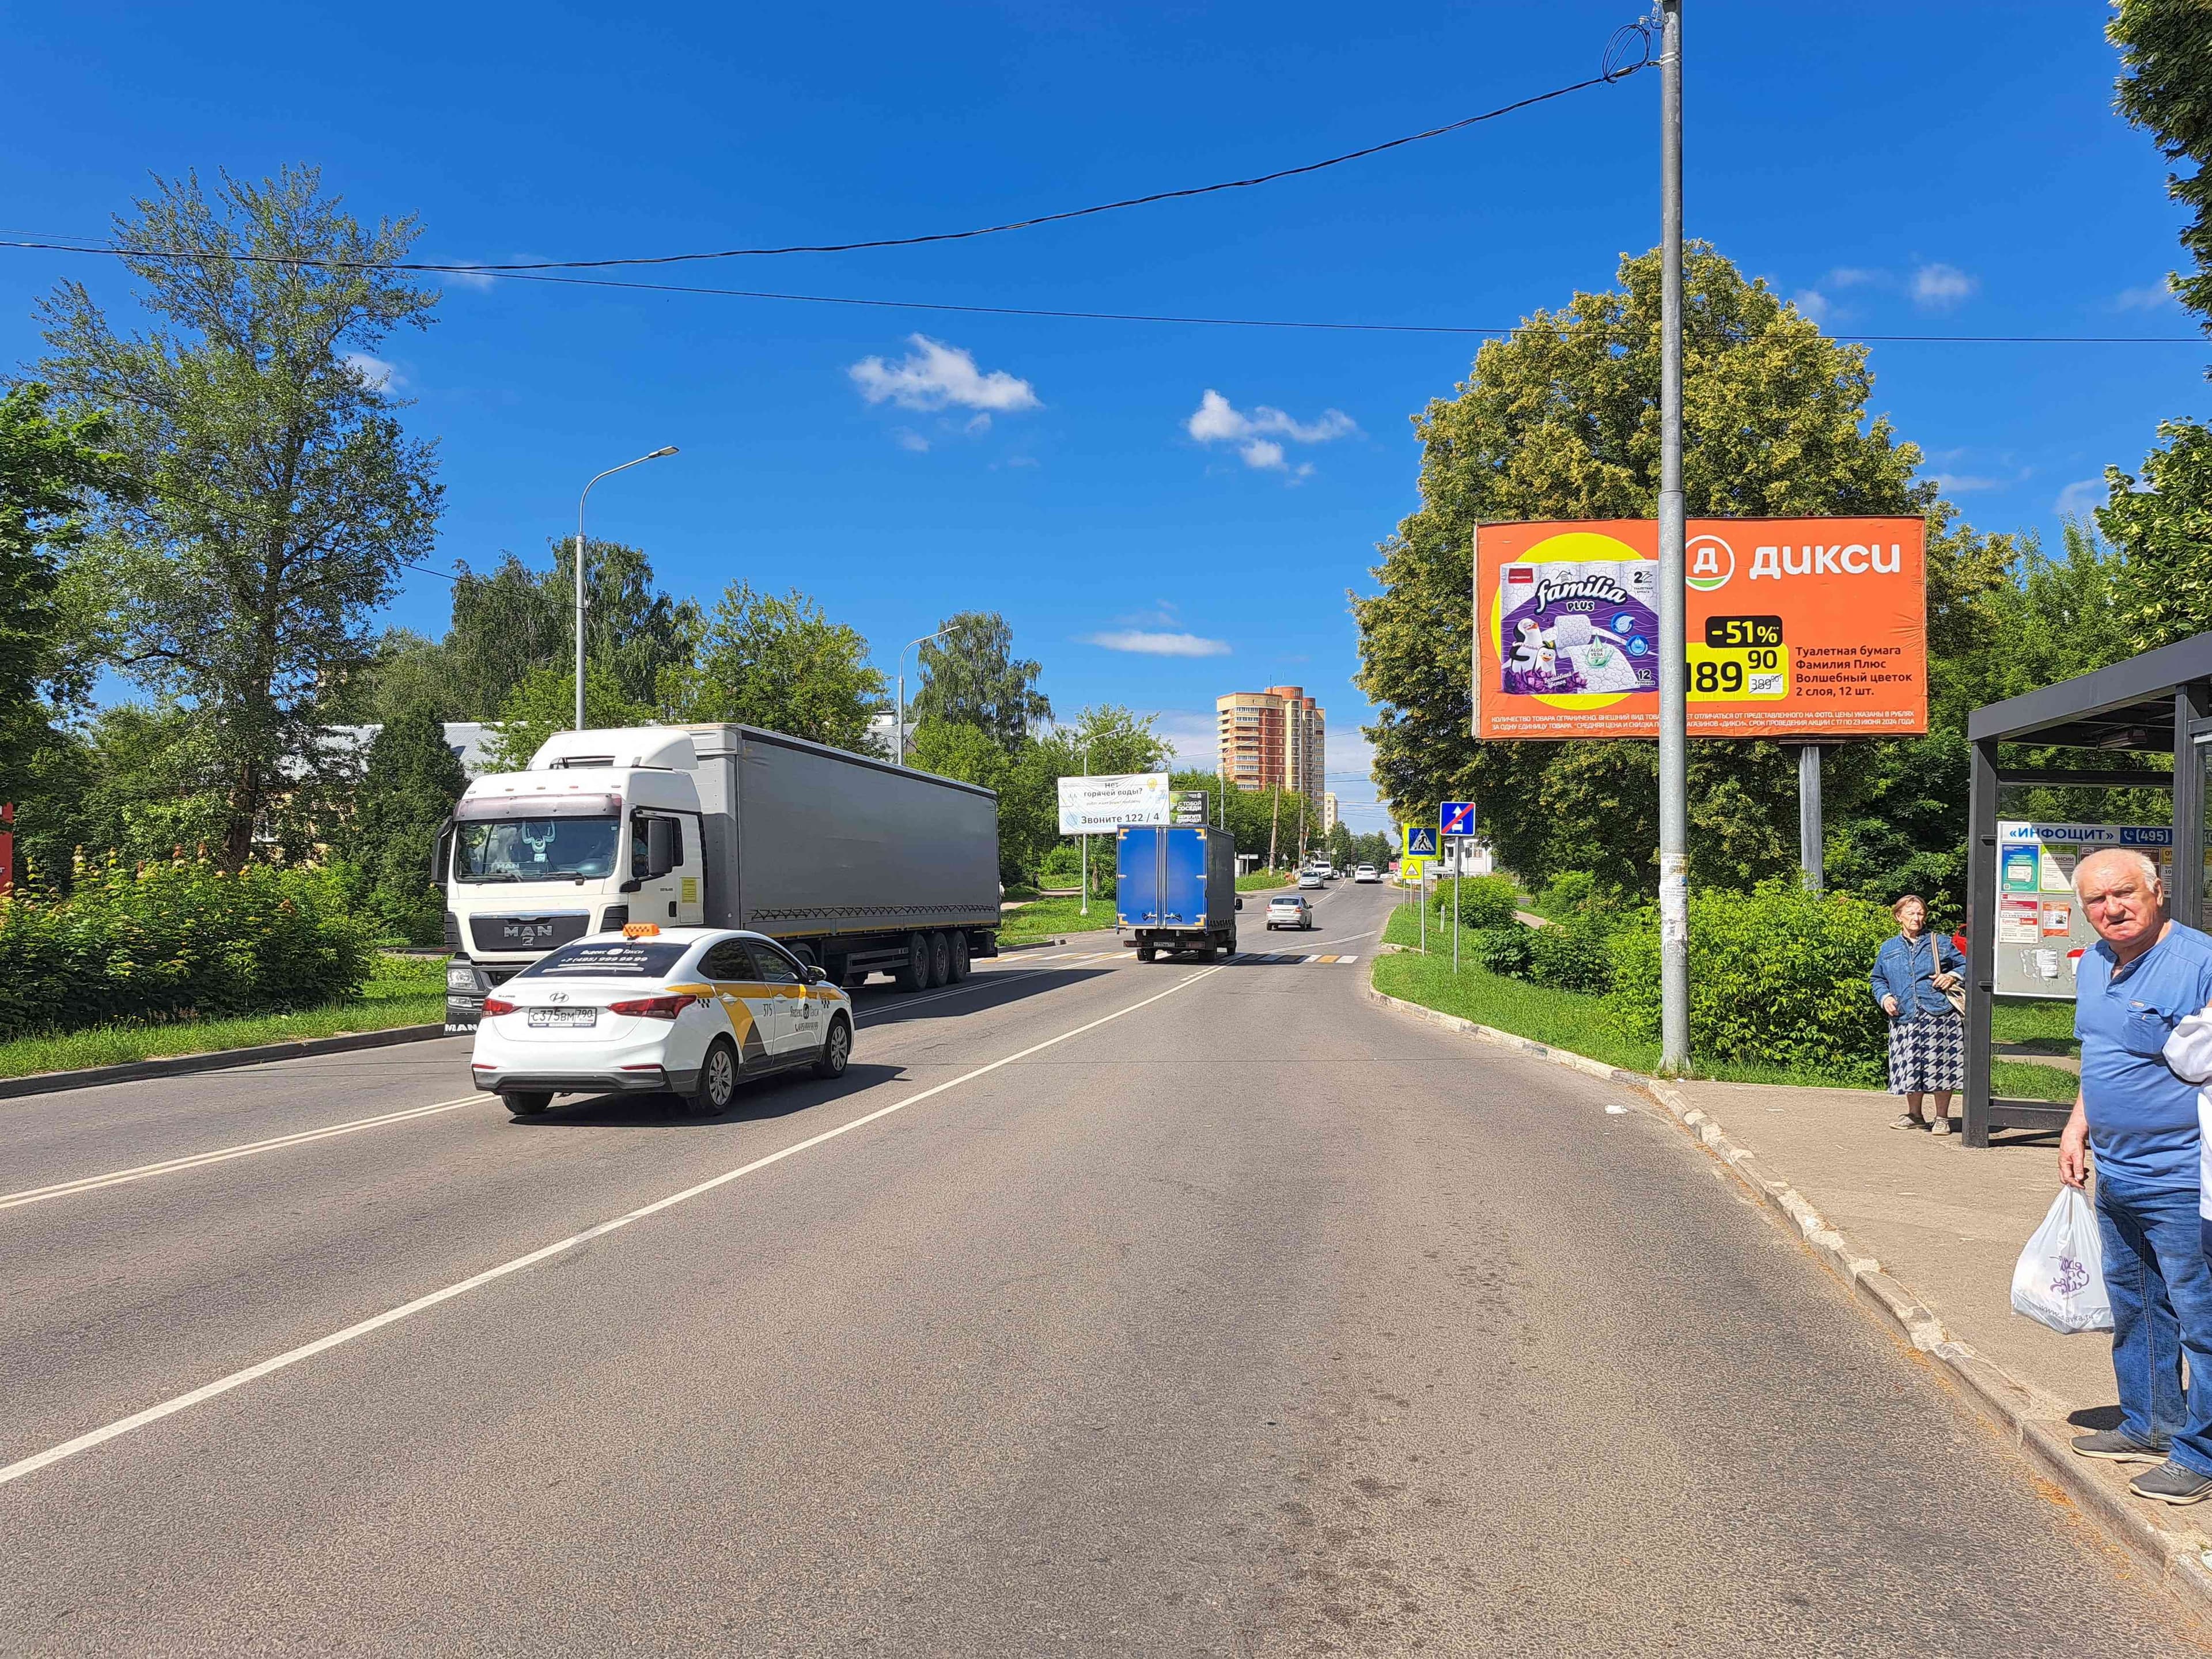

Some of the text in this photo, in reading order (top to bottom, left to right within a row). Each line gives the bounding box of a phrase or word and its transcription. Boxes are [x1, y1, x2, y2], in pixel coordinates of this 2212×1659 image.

[1634, 571, 1642, 583] 2
[1535, 576, 1627, 614] familia
[1566, 601, 1594, 611] PLUS
[1796, 645, 1901, 657] Туалетная бумага
[1748, 650, 1777, 669] 90
[1796, 660, 1887, 669] Фамилия Плюс
[1638, 670, 1651, 680] 12
[1796, 672, 1912, 683] Волшебный цветок
[1796, 687, 1802, 696] 2
[1805, 688, 1836, 698] слоя,
[1839, 687, 1852, 695] 12
[1084, 788, 1143, 798] горячей воды?
[1081, 813, 1160, 824] Звоните 122 / 4
[2009, 827, 2113, 841] «ИНФОЩИТ»
[2135, 828, 2169, 843] (495)
[504, 926, 552, 937] MAN
[763, 1003, 772, 1017] 375
[445, 1024, 478, 1032] MAN
